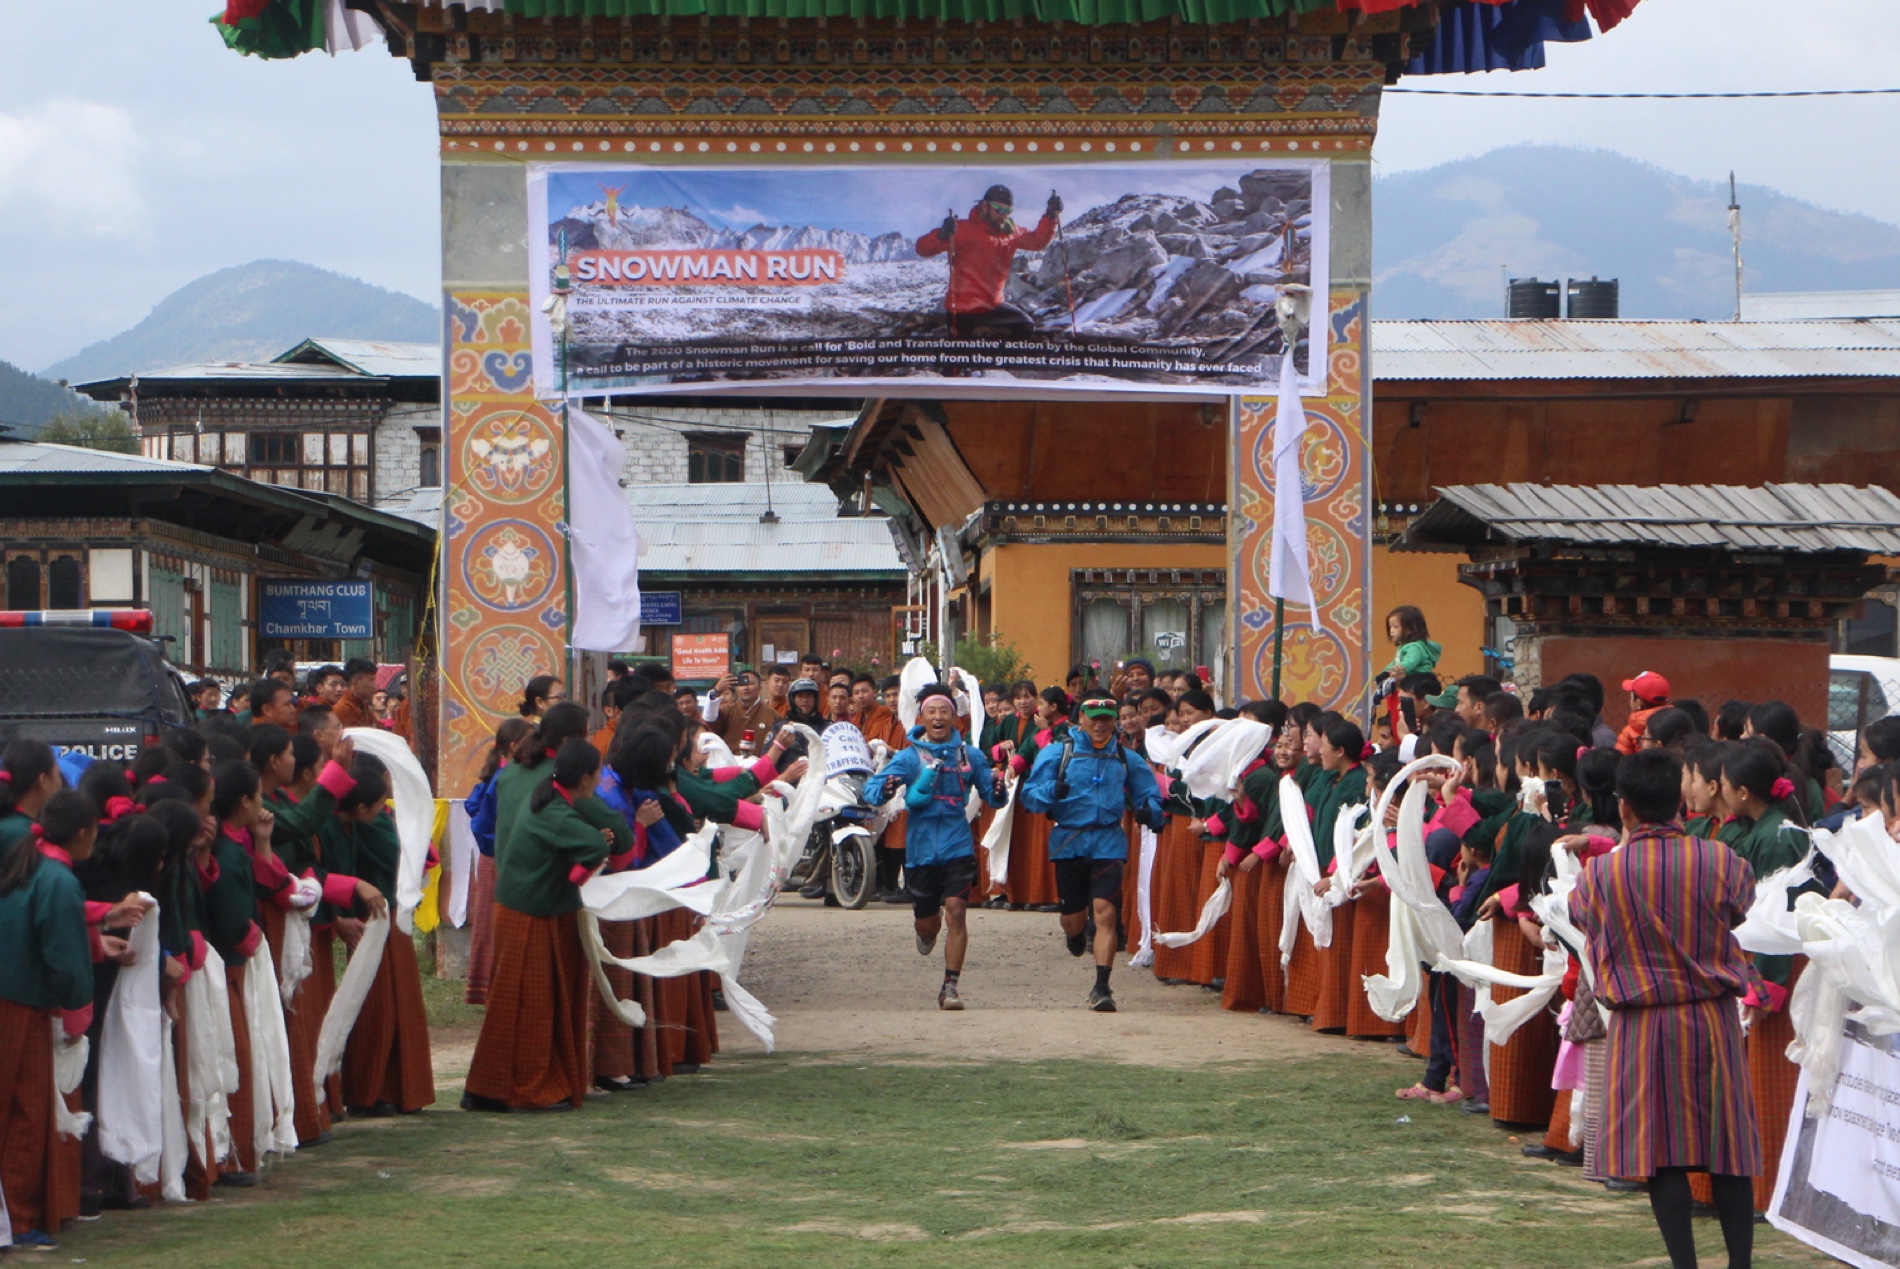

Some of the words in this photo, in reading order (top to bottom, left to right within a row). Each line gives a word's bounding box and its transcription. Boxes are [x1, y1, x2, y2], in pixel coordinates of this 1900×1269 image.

[577, 255, 758, 281] SNOWMAN
[767, 255, 836, 280] RUN
[576, 297, 594, 306] THE
[597, 297, 646, 305] ULTIMATE
[648, 296, 668, 304] RUN
[670, 296, 714, 304] AGAINST
[716, 296, 758, 304] CLIMATE
[760, 296, 802, 304] CHANGE
[625, 346, 648, 357] The
[651, 346, 682, 356] 2020
[685, 345, 748, 355] Snowman
[750, 344, 776, 354] Run
[779, 344, 788, 353] is
[801, 342, 823, 352] call
[825, 341, 843, 352] for
[845, 340, 876, 351] 'Bold
[879, 338, 902, 349] and
[905, 338, 1002, 349] Transformative'
[1004, 340, 1044, 350] action
[1046, 341, 1062, 353] by
[1064, 342, 1085, 352] the
[1087, 344, 1127, 353] Global
[1130, 345, 1206, 358] Community,
[586, 364, 608, 375] call
[610, 363, 623, 373] to
[625, 361, 640, 372] be
[642, 360, 668, 373] part
[671, 359, 684, 369] of
[686, 361, 694, 369] a
[696, 358, 743, 368] historic
[745, 356, 812, 367] movement
[815, 354, 833, 364] for
[836, 353, 875, 366] saving
[877, 354, 899, 363] our
[901, 352, 937, 363] home
[939, 352, 970, 363] from
[972, 353, 993, 363] the
[995, 355, 1048, 366] greatest
[1049, 356, 1082, 367] crisis
[1084, 356, 1110, 367] that
[1112, 357, 1173, 372] humanity
[1175, 360, 1197, 372] has
[1198, 362, 1225, 372] ever
[1227, 361, 1262, 374] faced
[266, 585, 334, 597] BUMTHANG
[336, 585, 367, 596] CLUB
[266, 622, 328, 634] Chamkhar
[333, 622, 366, 634] Town
[59, 744, 138, 760] POLICE
[826, 757, 859, 771] TRAFFIC
